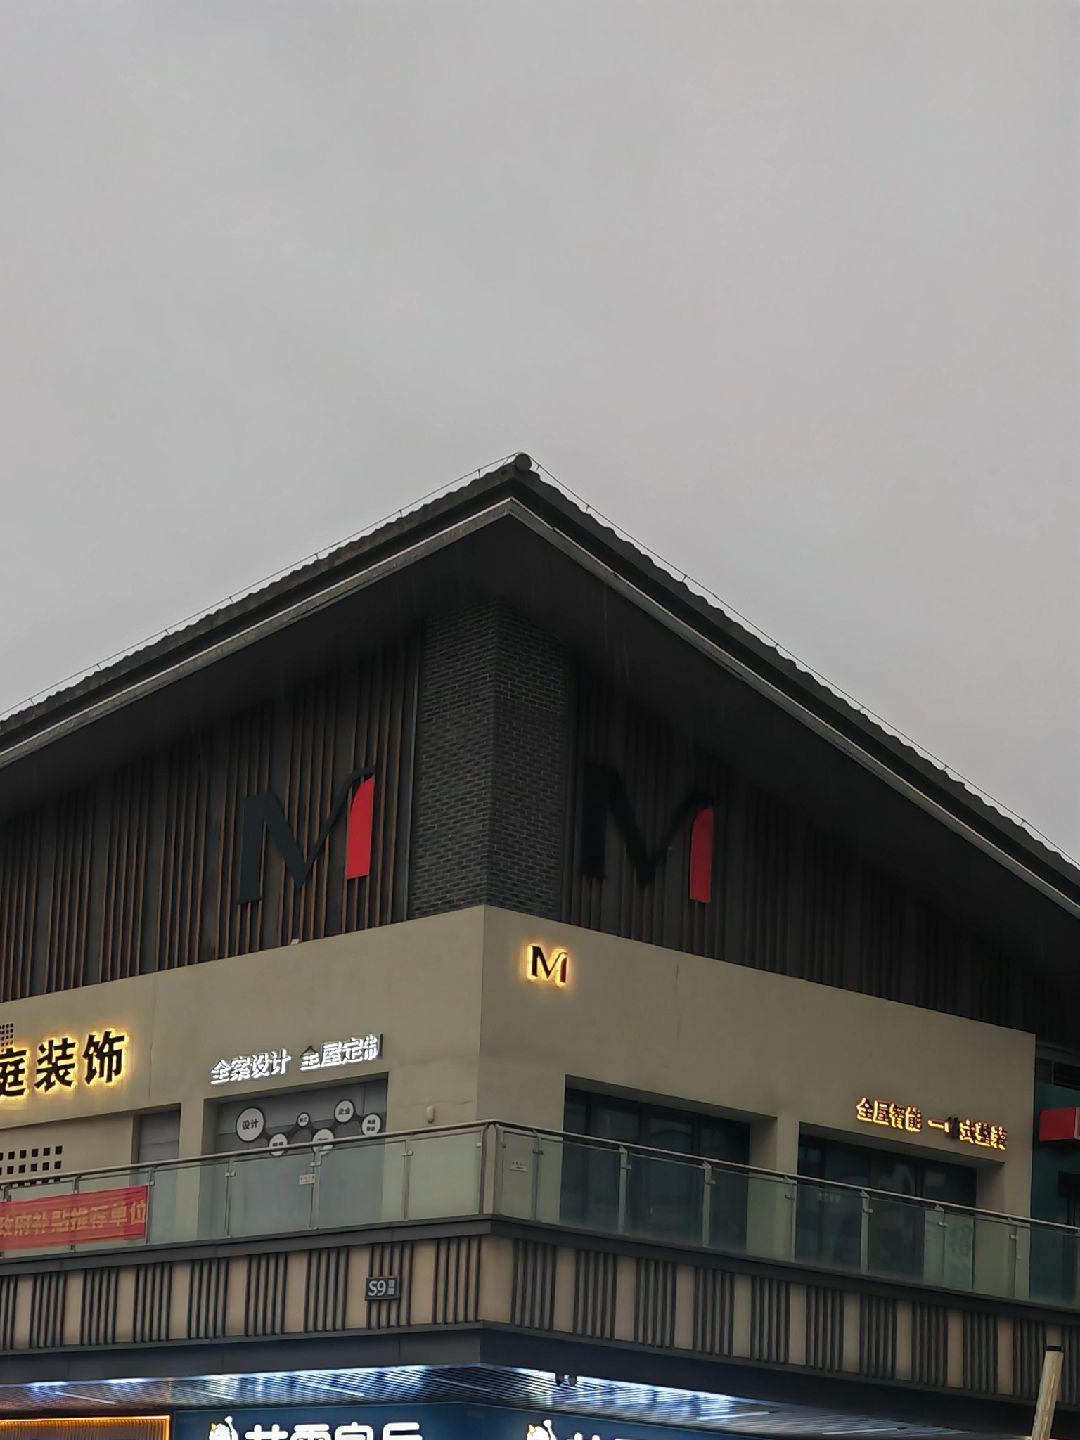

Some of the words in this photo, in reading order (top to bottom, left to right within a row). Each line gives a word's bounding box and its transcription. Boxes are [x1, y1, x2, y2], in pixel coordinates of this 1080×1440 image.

[210, 1048, 291, 1085] 全案设计
[299, 1033, 384, 1072] 全屋定制
[367, 1279, 386, 1297] S9
